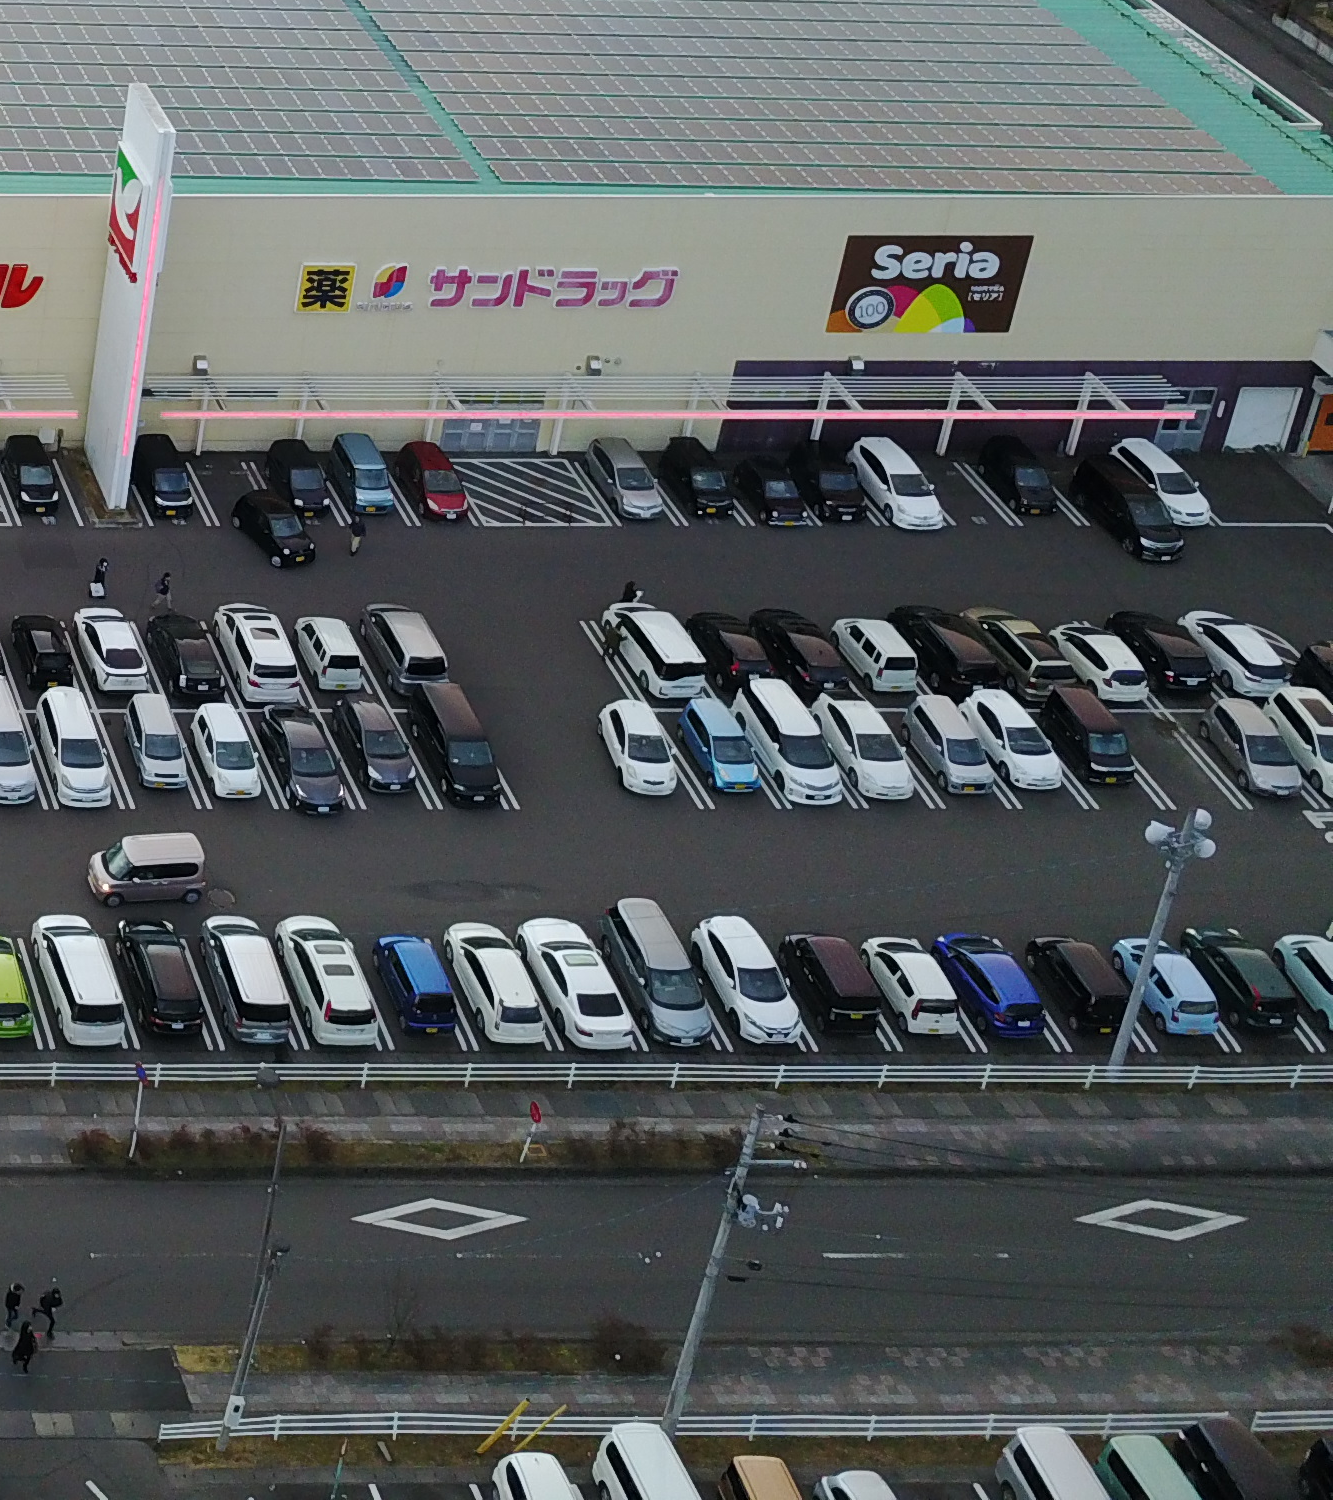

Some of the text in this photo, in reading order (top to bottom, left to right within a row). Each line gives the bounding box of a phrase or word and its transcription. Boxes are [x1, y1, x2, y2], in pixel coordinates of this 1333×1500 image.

[871, 241, 1000, 279] Seria
[301, 269, 351, 309] 薬
[428, 266, 680, 308] サンドラッグ
[858, 301, 886, 319] 100
